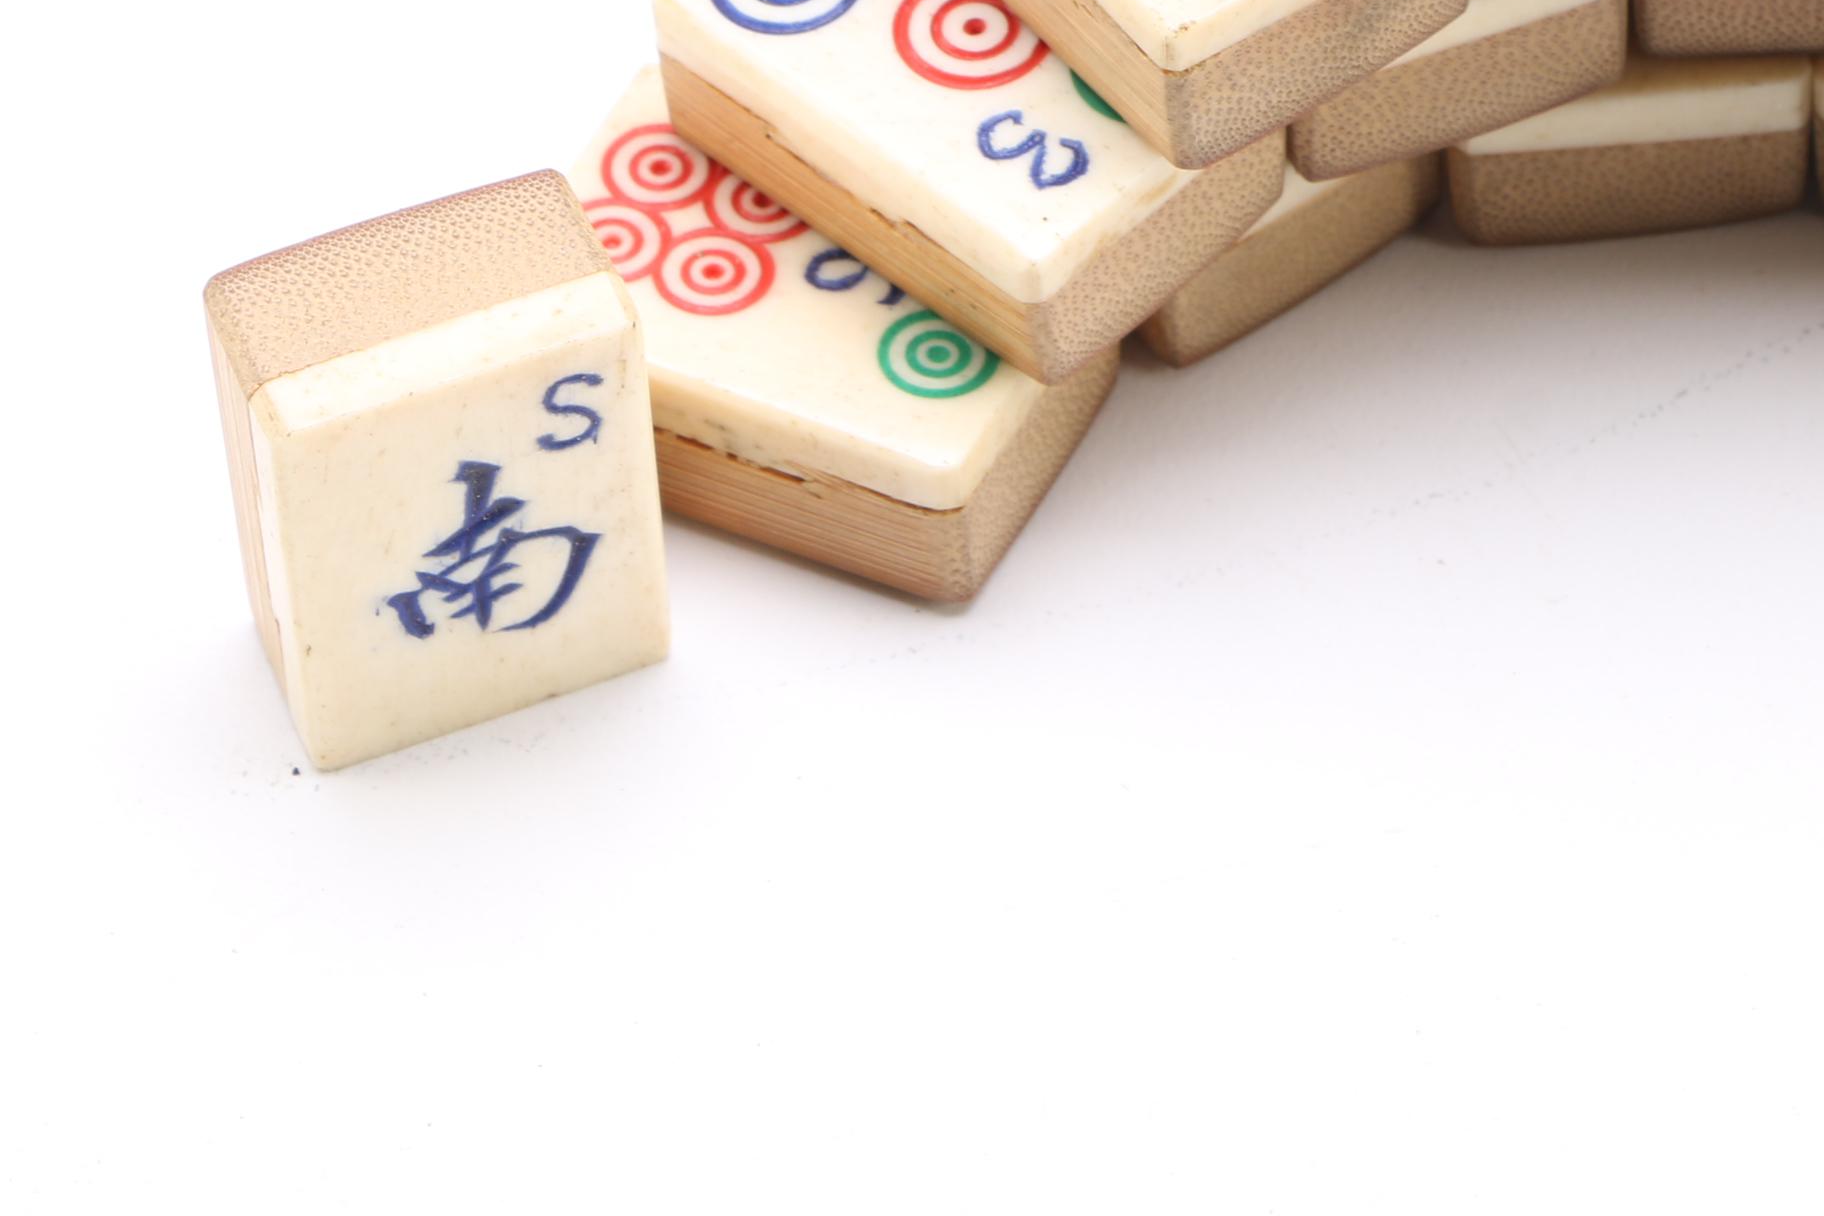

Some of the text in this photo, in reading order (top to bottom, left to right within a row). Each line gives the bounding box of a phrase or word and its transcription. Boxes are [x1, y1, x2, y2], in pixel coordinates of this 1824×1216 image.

[976, 108, 1091, 191] 3
[536, 372, 604, 452] S
[380, 459, 604, 640] 南
